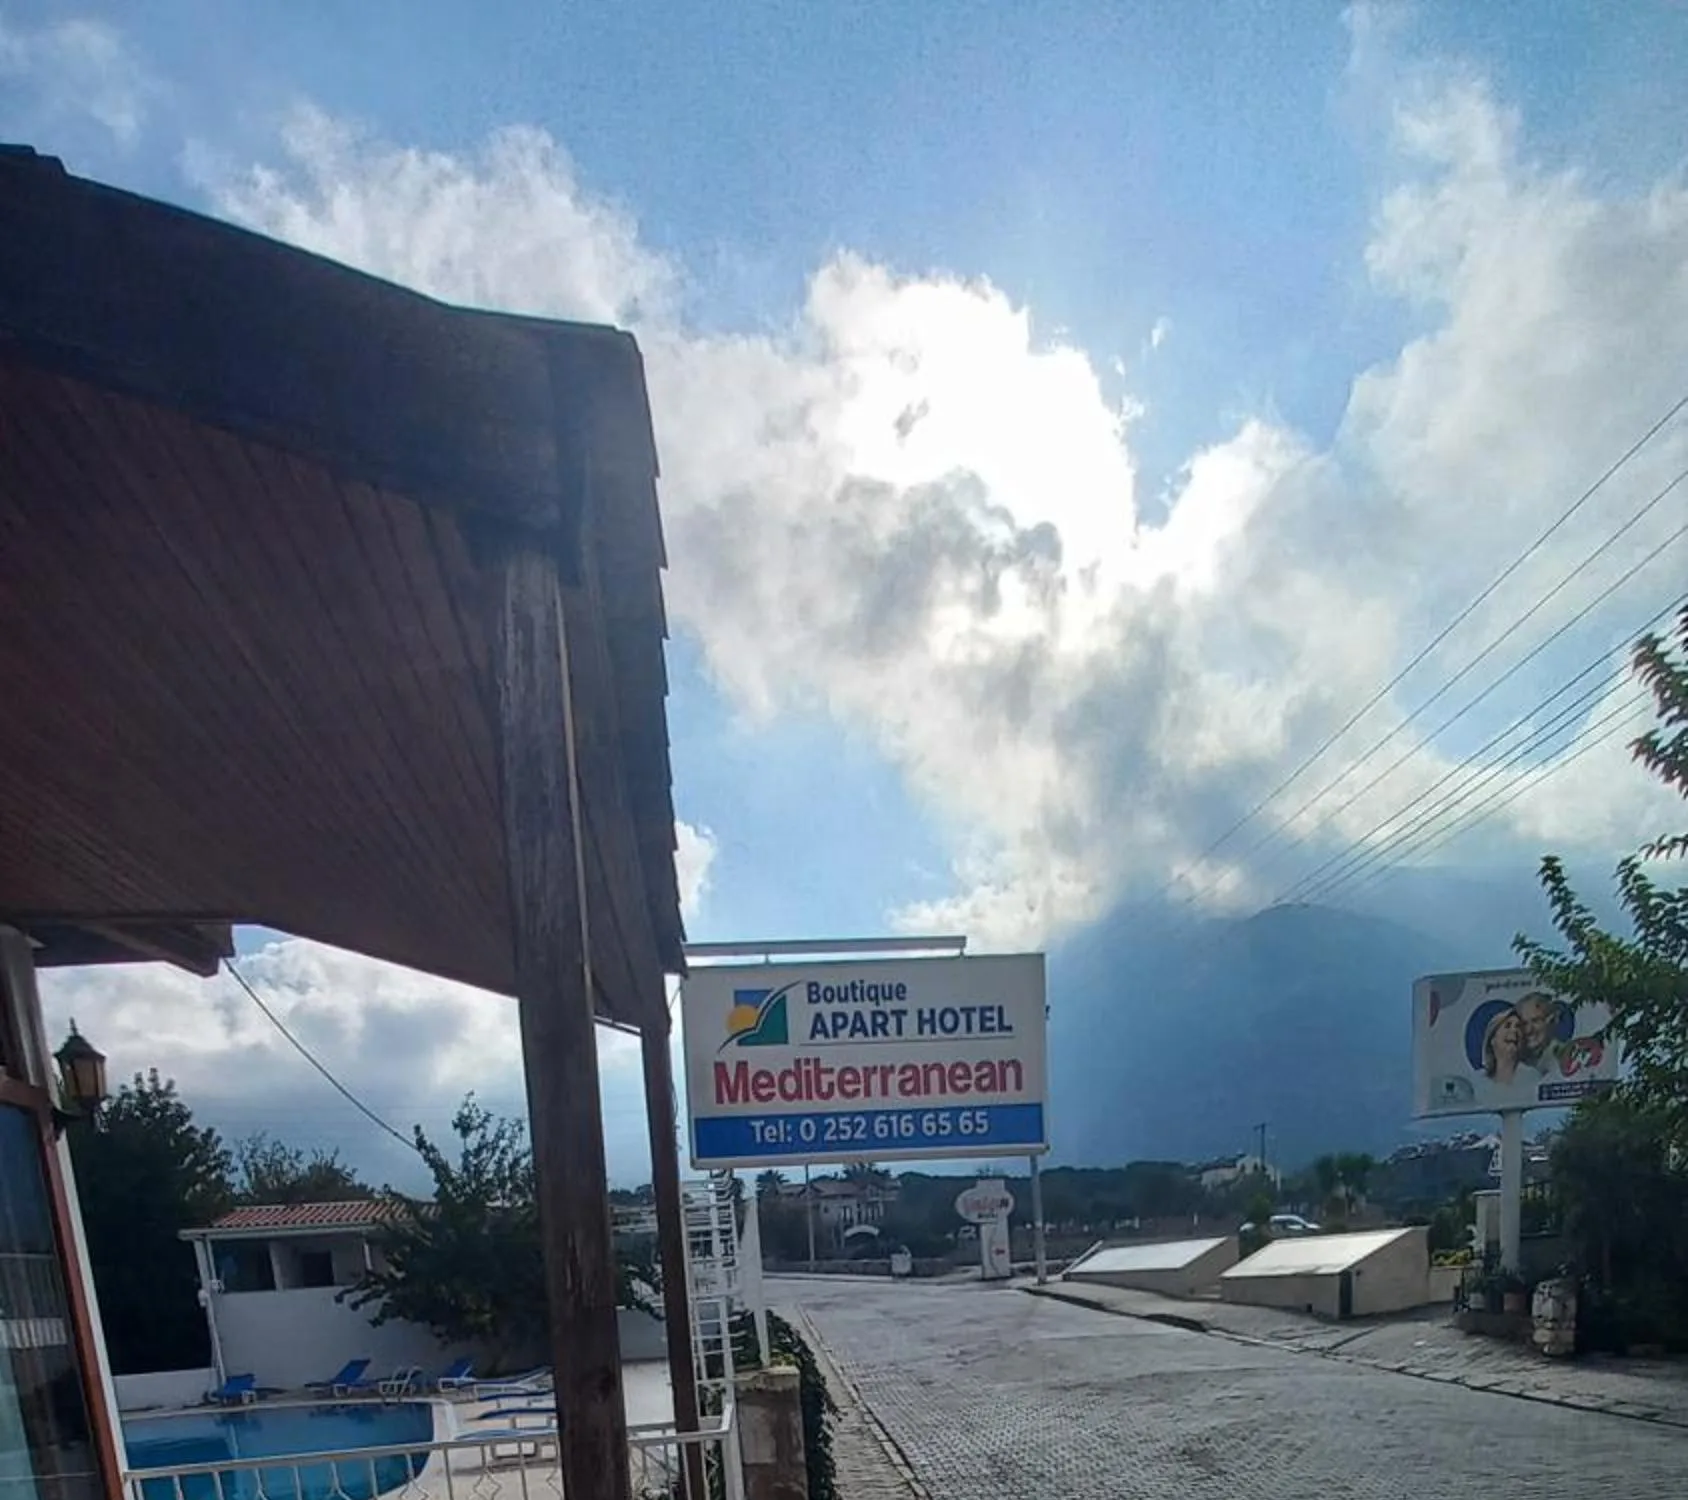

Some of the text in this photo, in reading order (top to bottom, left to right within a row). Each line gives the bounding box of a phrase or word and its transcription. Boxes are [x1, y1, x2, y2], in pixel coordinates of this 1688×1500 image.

[806, 979, 907, 1007] Boutique
[808, 1005, 1013, 1041] APART HOTEL
[713, 1056, 1023, 1105] Mediterranean
[750, 1111, 990, 1144] Tel: 0 252 616 65 65
